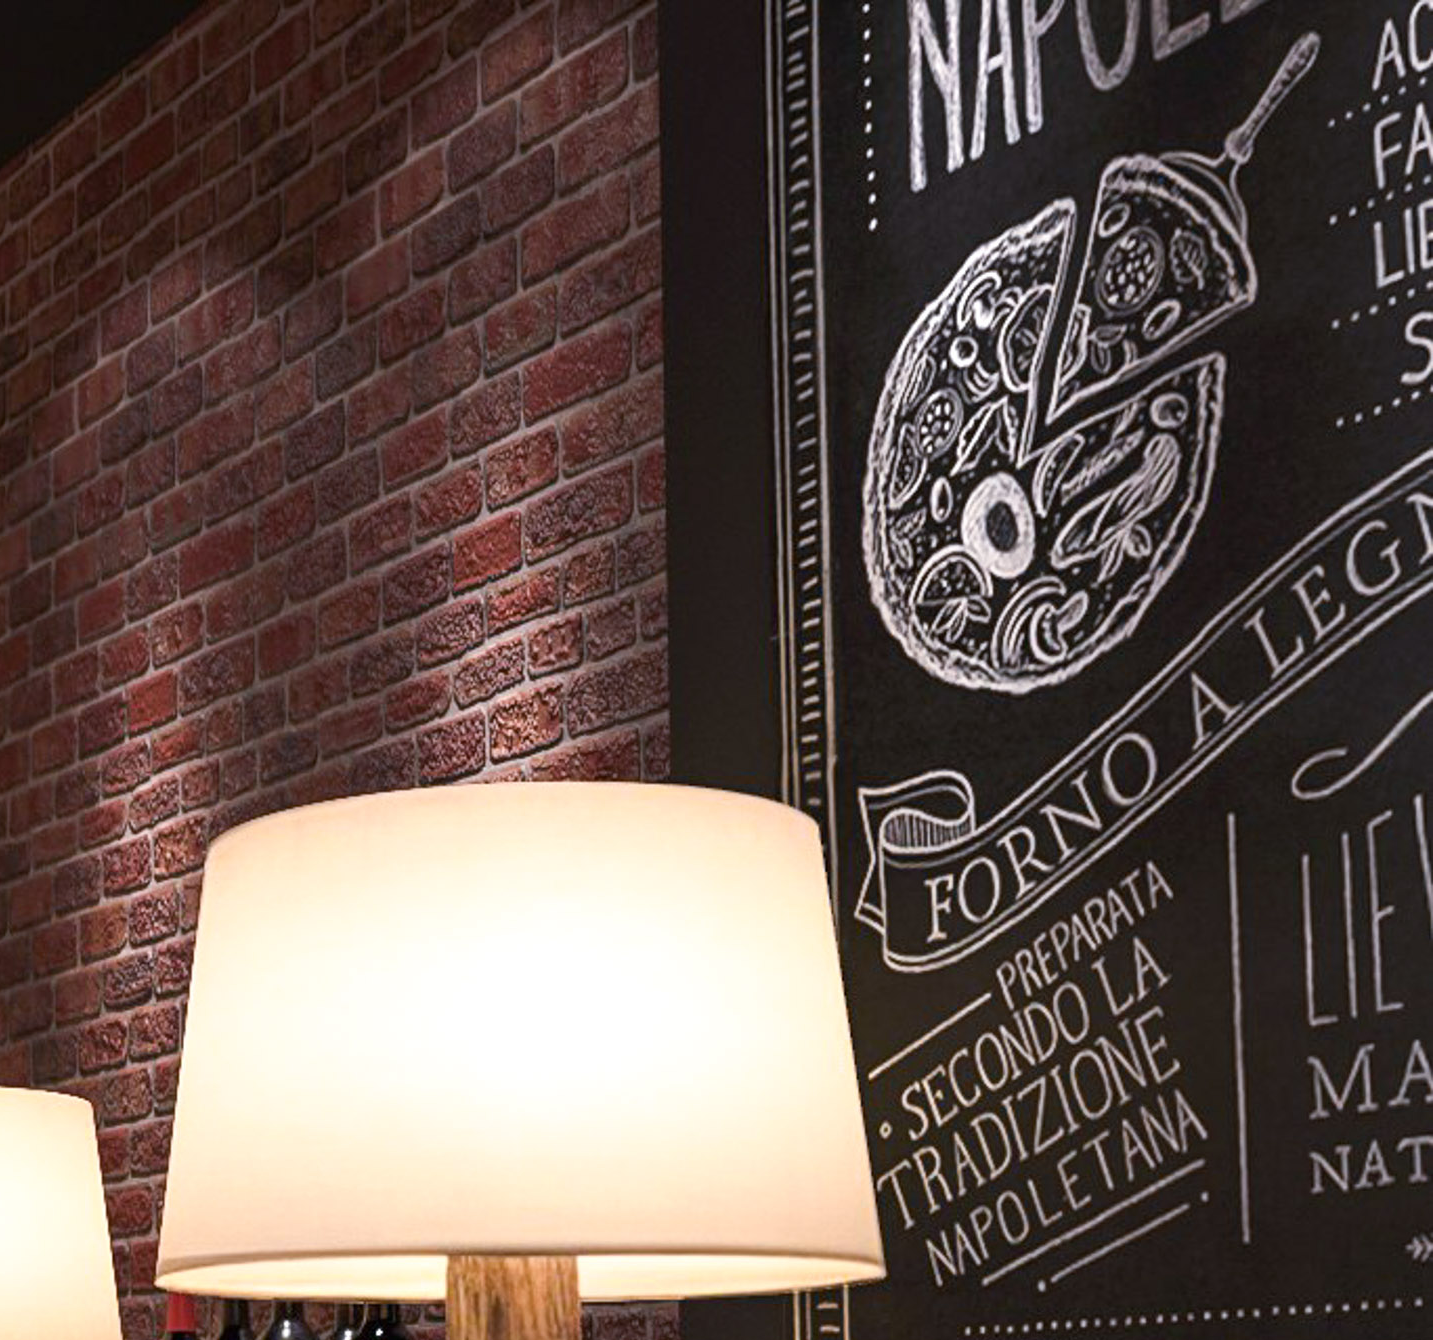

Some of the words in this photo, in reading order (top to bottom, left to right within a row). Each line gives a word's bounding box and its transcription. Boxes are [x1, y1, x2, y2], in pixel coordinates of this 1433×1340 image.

[1372, 102, 1433, 190] FA
[923, 732, 1158, 943] FORNO
[1190, 671, 1243, 750] A
[995, 860, 1174, 1009] PREPARATA
[877, 1006, 1181, 1231] TRADIZIONE
[901, 981, 1090, 1142] SECONDO
[1093, 936, 1171, 1017] LA
[1307, 1039, 1433, 1119] MA
[926, 1090, 1208, 1286] NAPOLETANA
[1309, 1135, 1433, 1194] NAT
